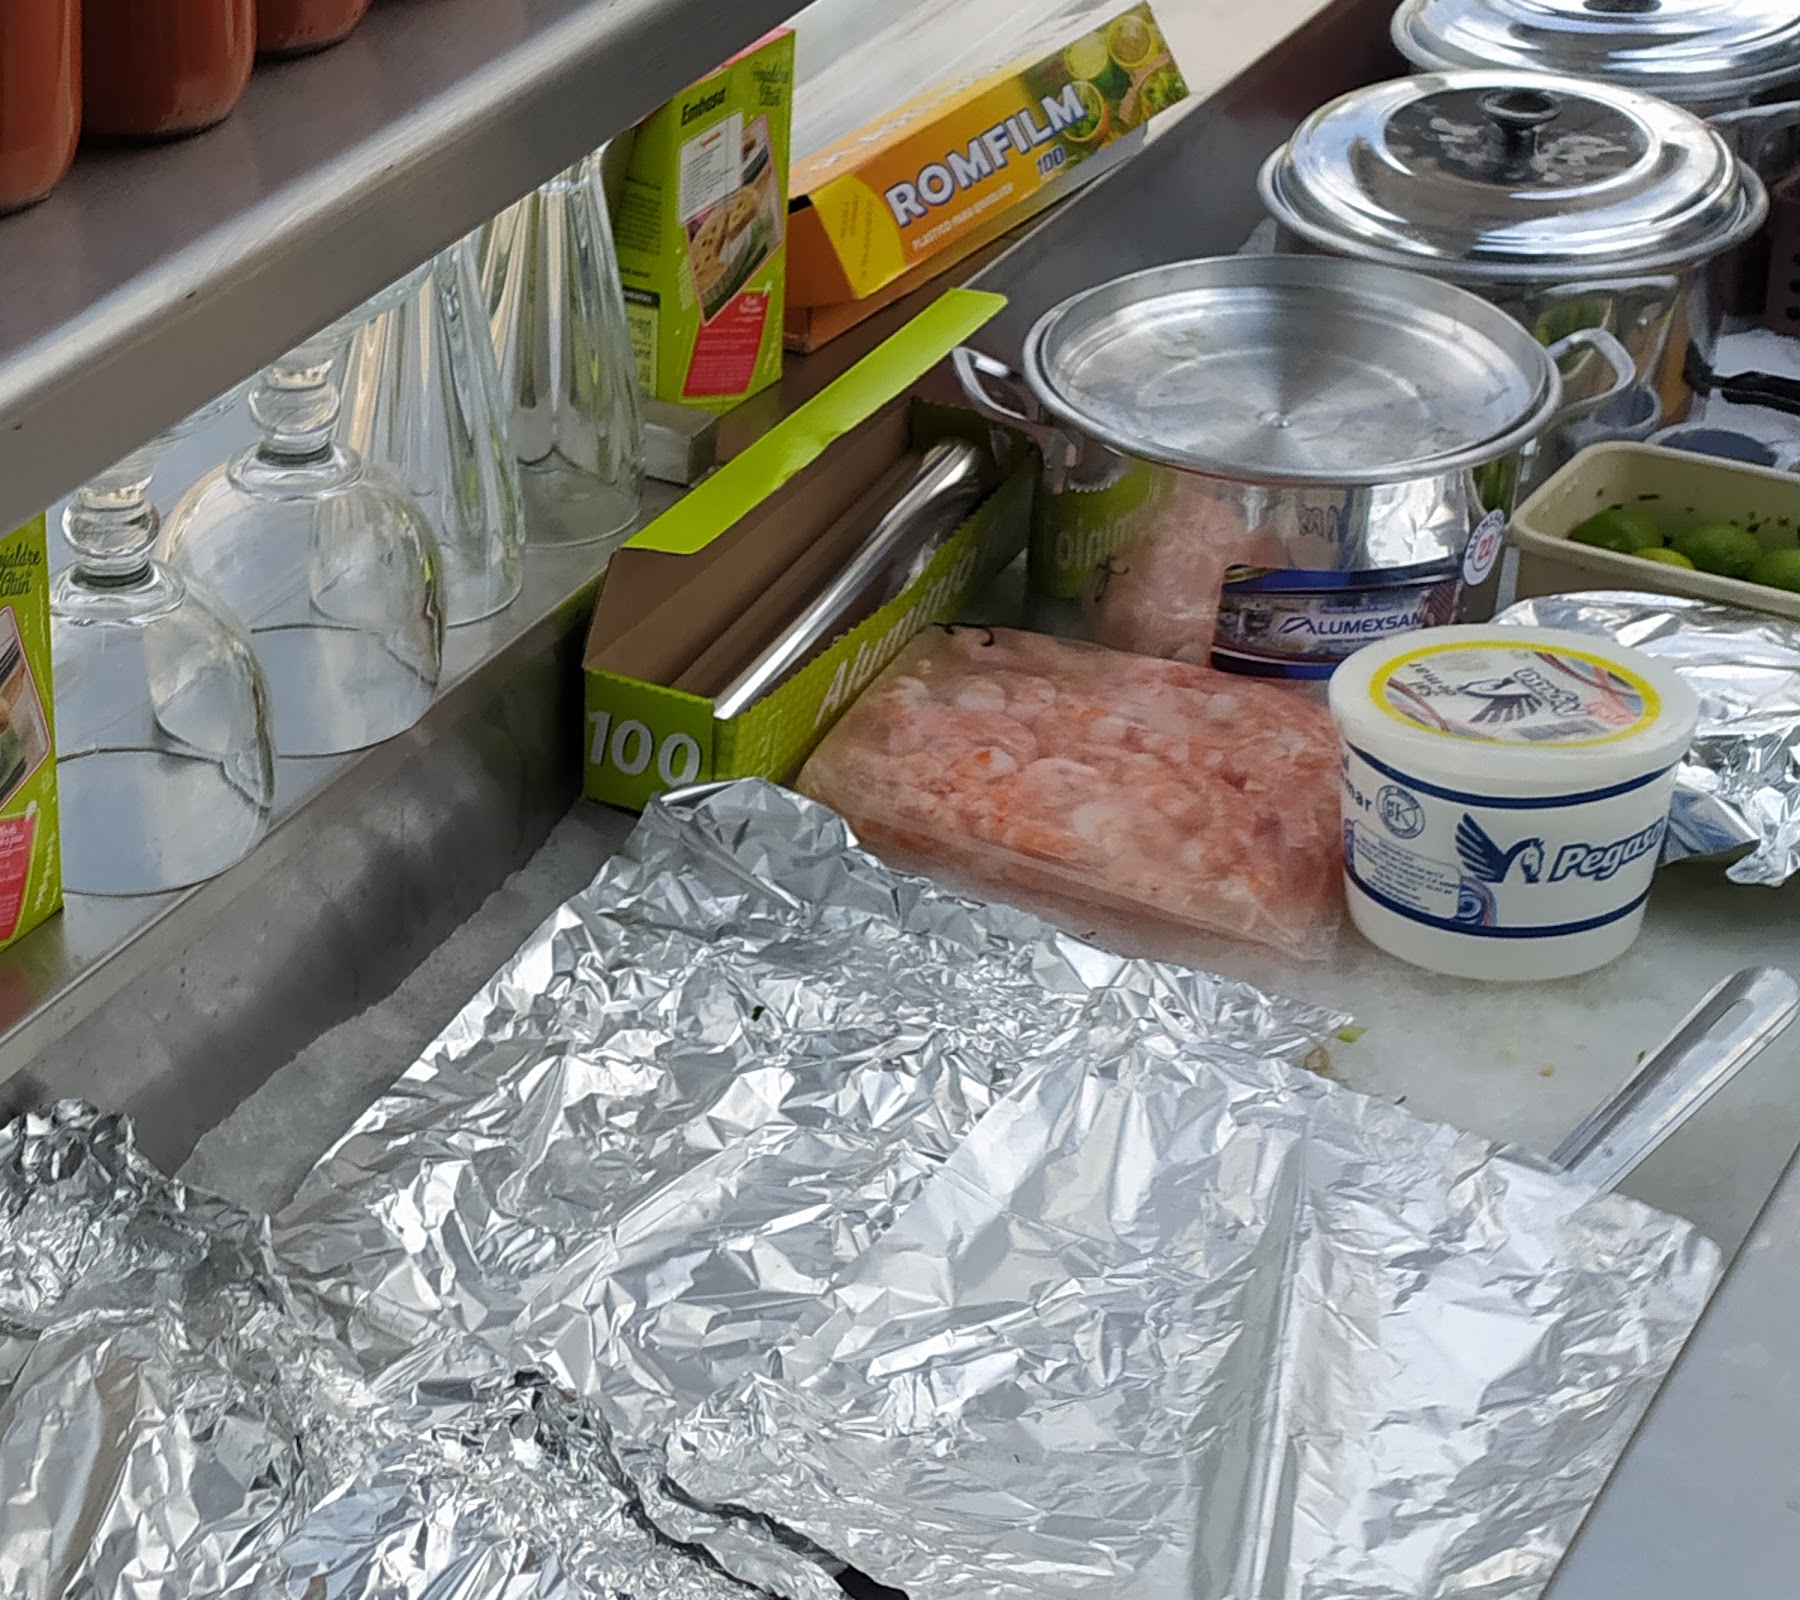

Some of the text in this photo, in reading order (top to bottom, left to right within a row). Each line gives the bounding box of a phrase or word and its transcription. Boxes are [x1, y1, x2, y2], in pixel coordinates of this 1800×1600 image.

[680, 88, 726, 127] Embasa
[884, 82, 1087, 228] ROMFILM
[1037, 144, 1066, 176] 100
[587, 711, 701, 788] 100
